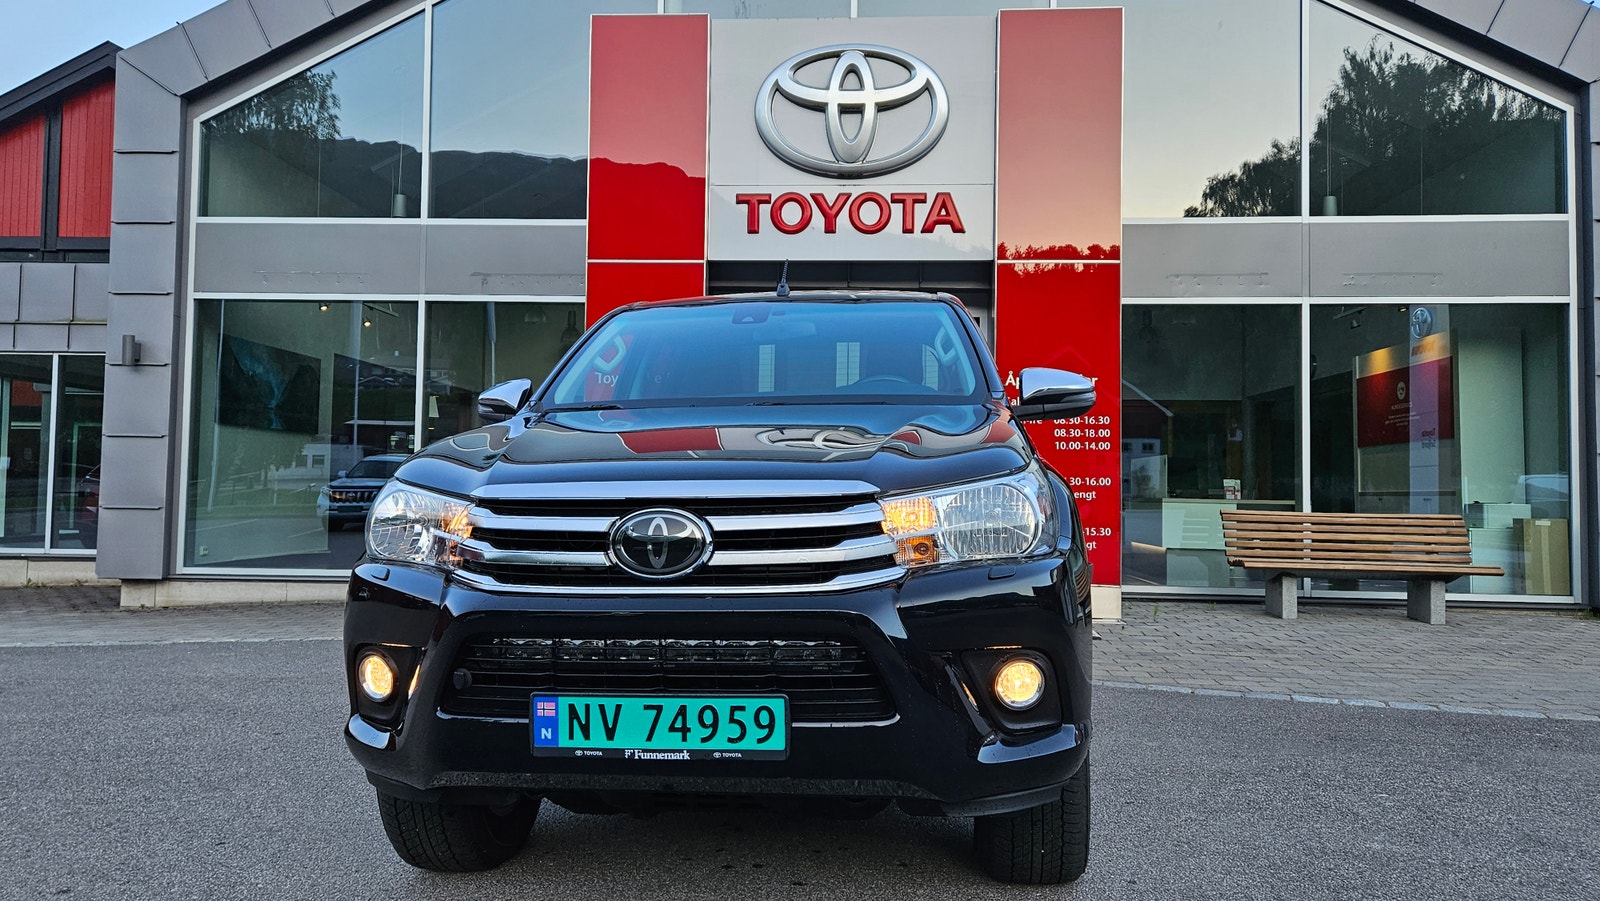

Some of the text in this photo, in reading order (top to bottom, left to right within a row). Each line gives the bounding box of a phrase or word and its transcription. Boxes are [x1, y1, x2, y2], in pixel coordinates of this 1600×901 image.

[736, 192, 966, 235] TOYOTA
[595, 372, 619, 387] Toy
[1054, 428, 1111, 438] 08.30-18.00
[1055, 441, 1111, 451] 10.00-14.00
[1069, 477, 1111, 486] 30-16.00
[1074, 490, 1097, 501] engt
[568, 703, 776, 745] NV 74959
[541, 727, 552, 740] N
[634, 749, 690, 760] Funnemark
